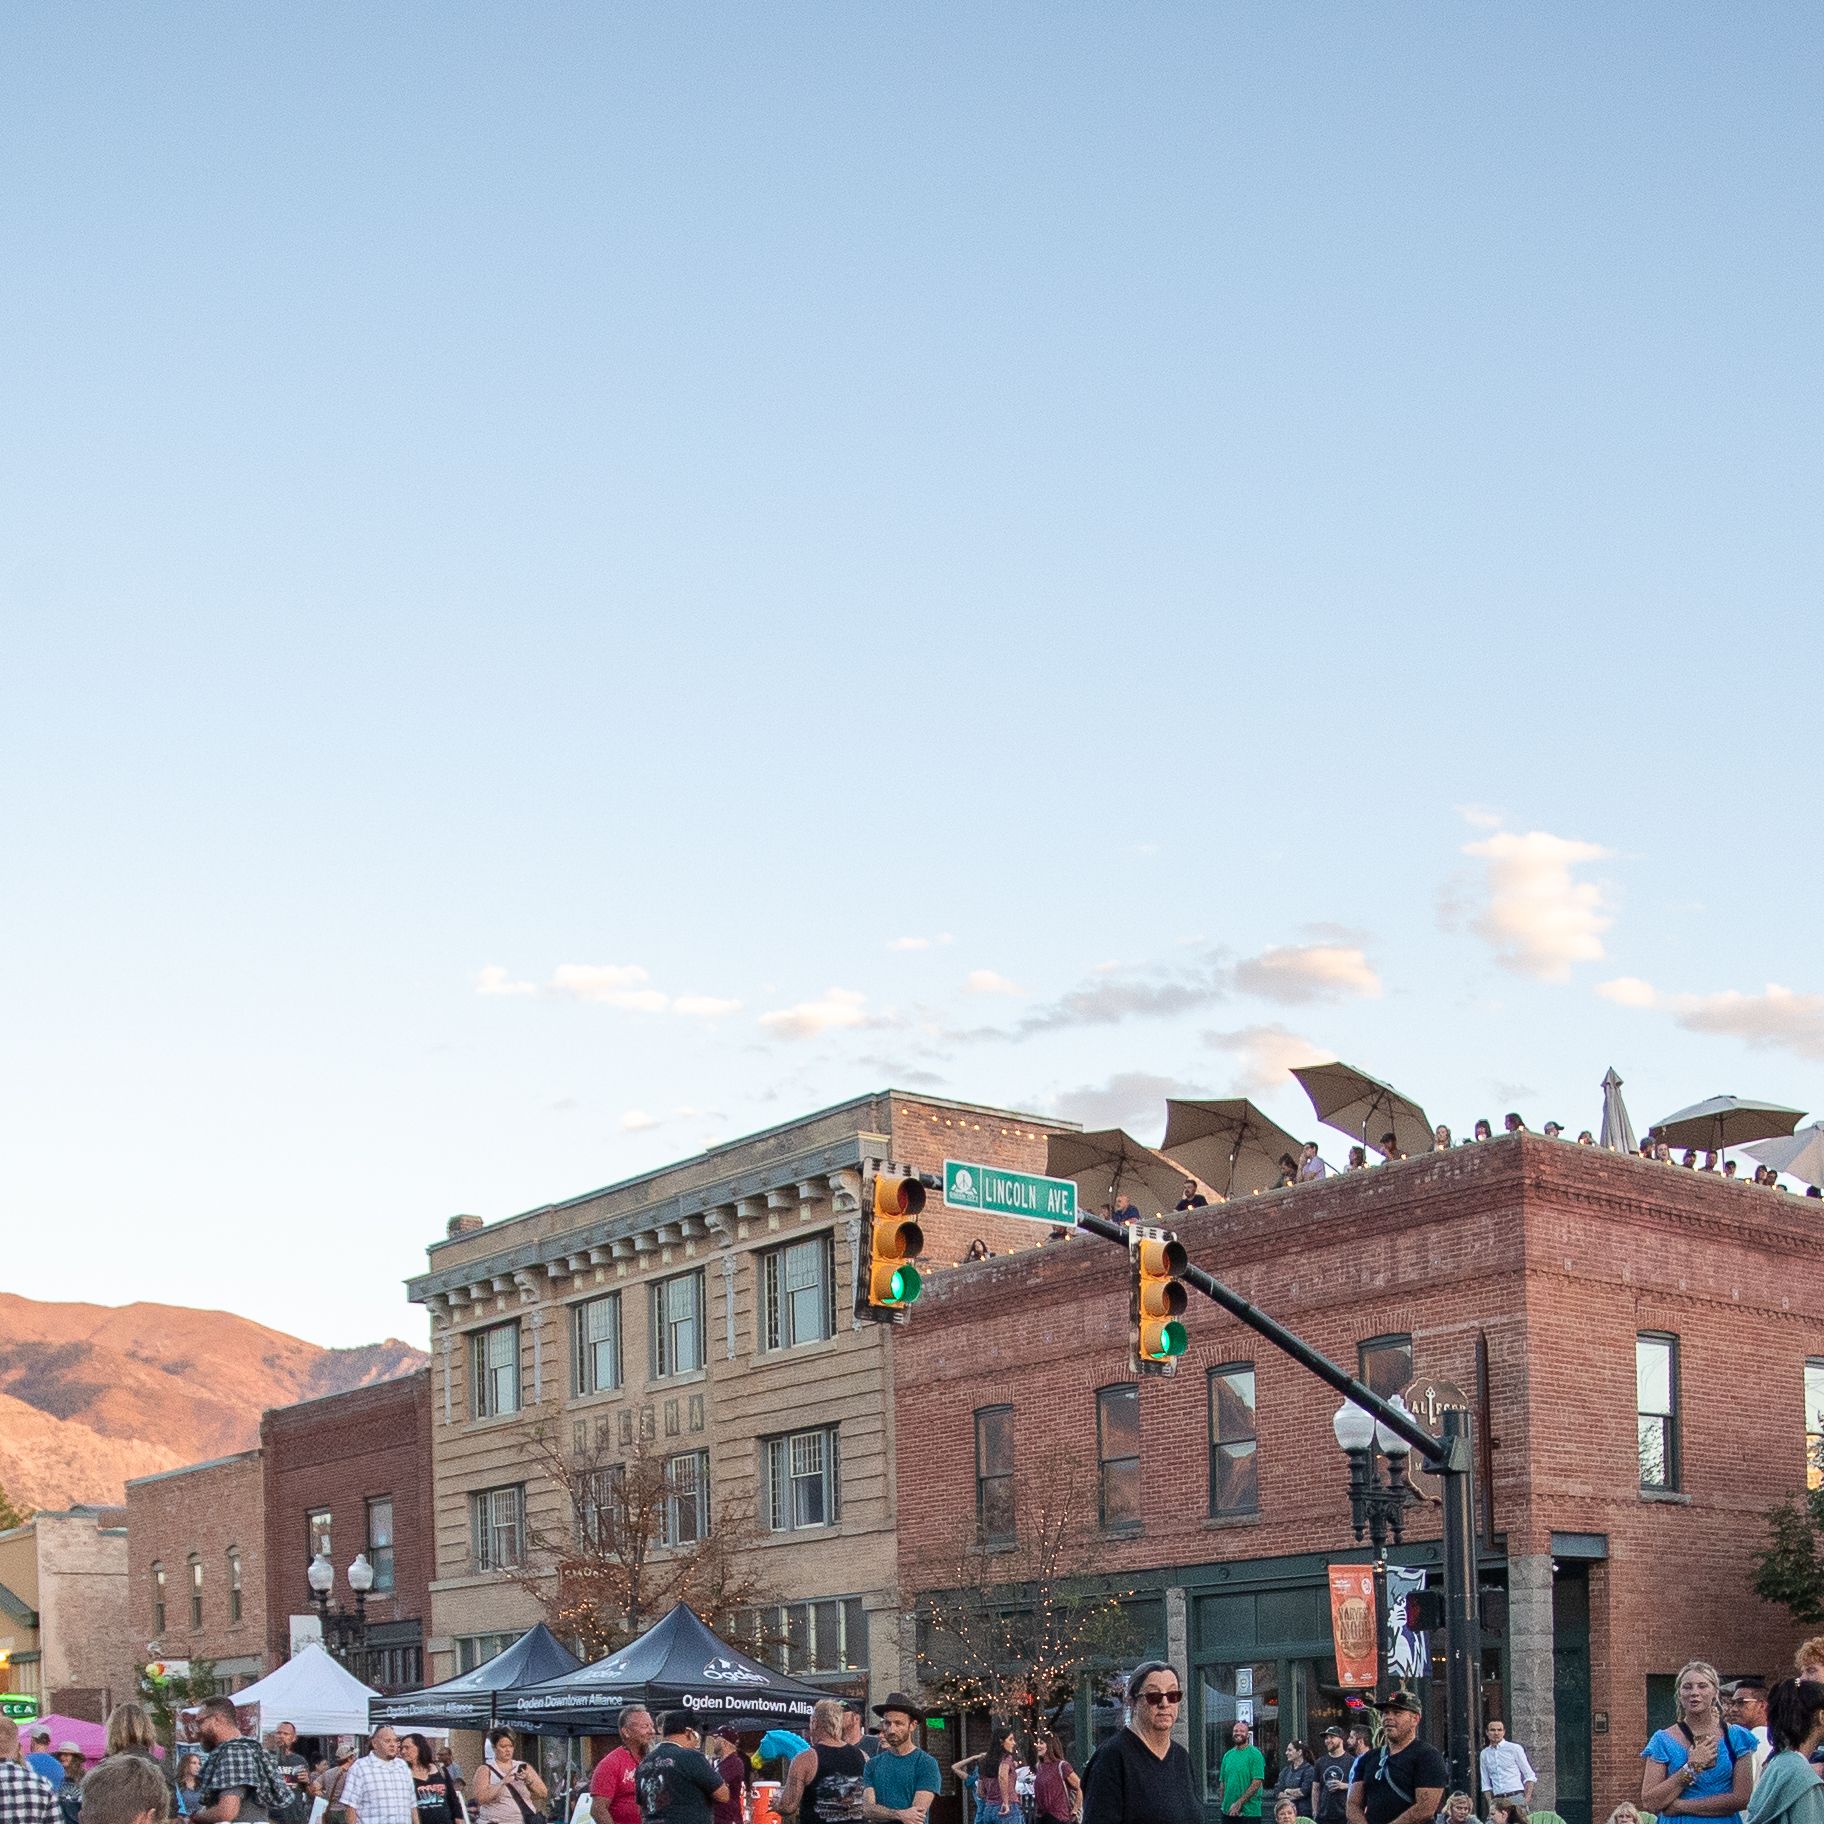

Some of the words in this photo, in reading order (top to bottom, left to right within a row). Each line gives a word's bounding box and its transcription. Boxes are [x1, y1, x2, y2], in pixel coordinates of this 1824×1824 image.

[984, 1177, 1037, 1209] LINCOLN
[1047, 1187, 1074, 1216] AVE.
[702, 1669, 771, 1686] Ogden
[517, 1697, 543, 1713] Ogden
[544, 1693, 588, 1709] Downtown
[589, 1692, 623, 1706] Alliance
[682, 1694, 723, 1711] Ogden
[725, 1696, 788, 1713] Downtown
[788, 1699, 815, 1715] Allia
